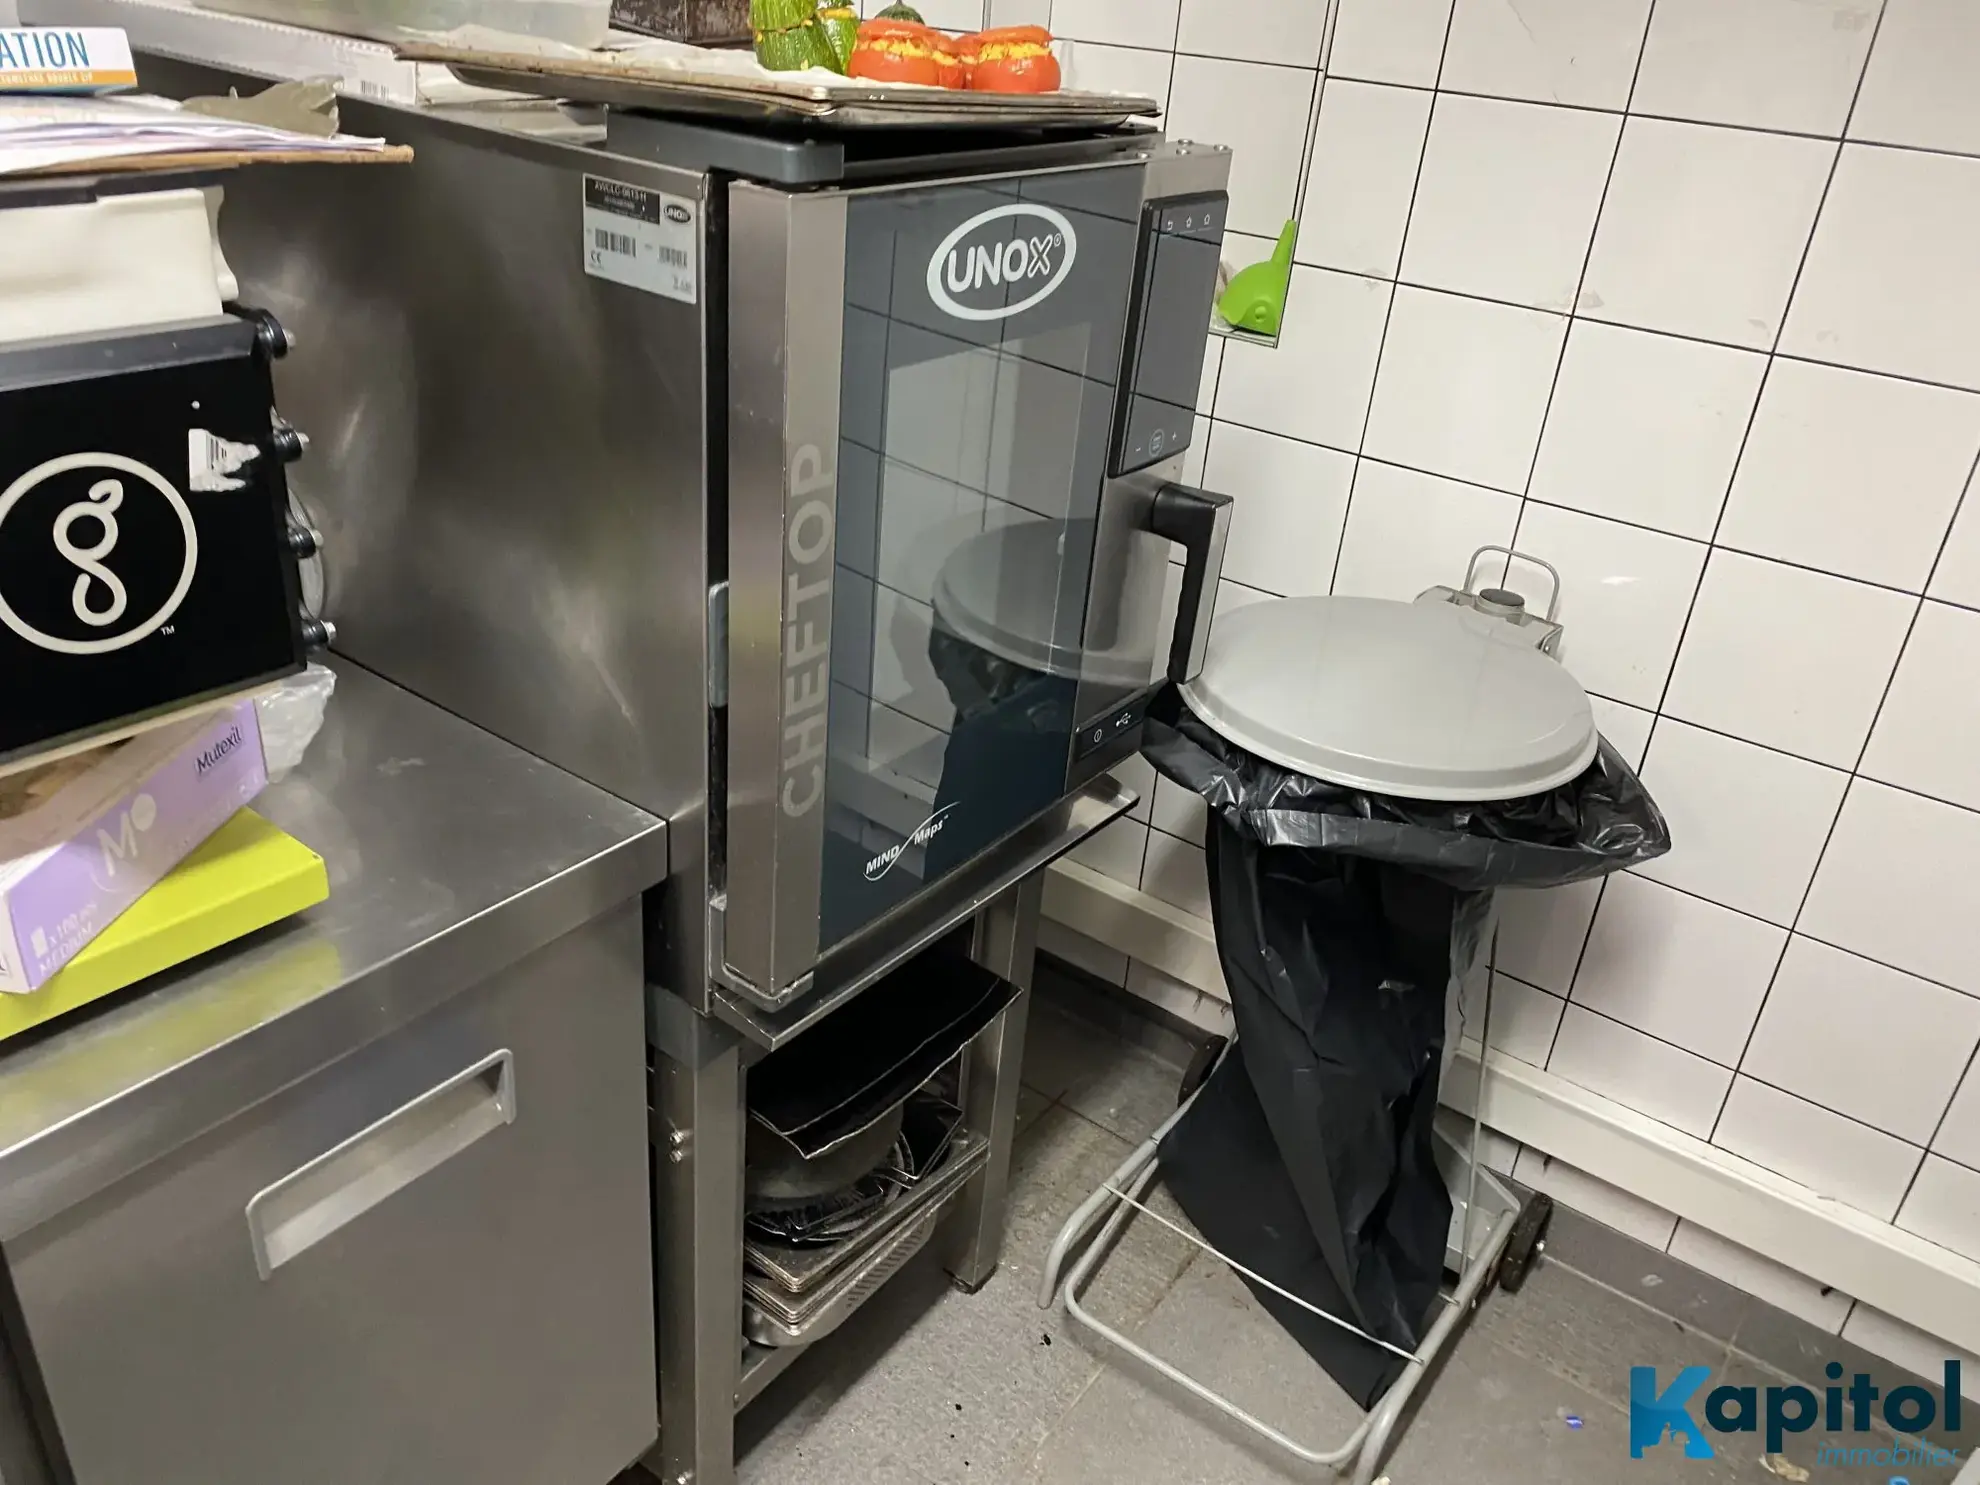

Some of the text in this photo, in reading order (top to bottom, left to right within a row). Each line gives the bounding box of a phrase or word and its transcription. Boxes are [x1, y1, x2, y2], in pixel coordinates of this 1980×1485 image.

[782, 443, 836, 818] CHEFTOP
[196, 726, 242, 774] Mutexil
[865, 844, 900, 875] MIND
